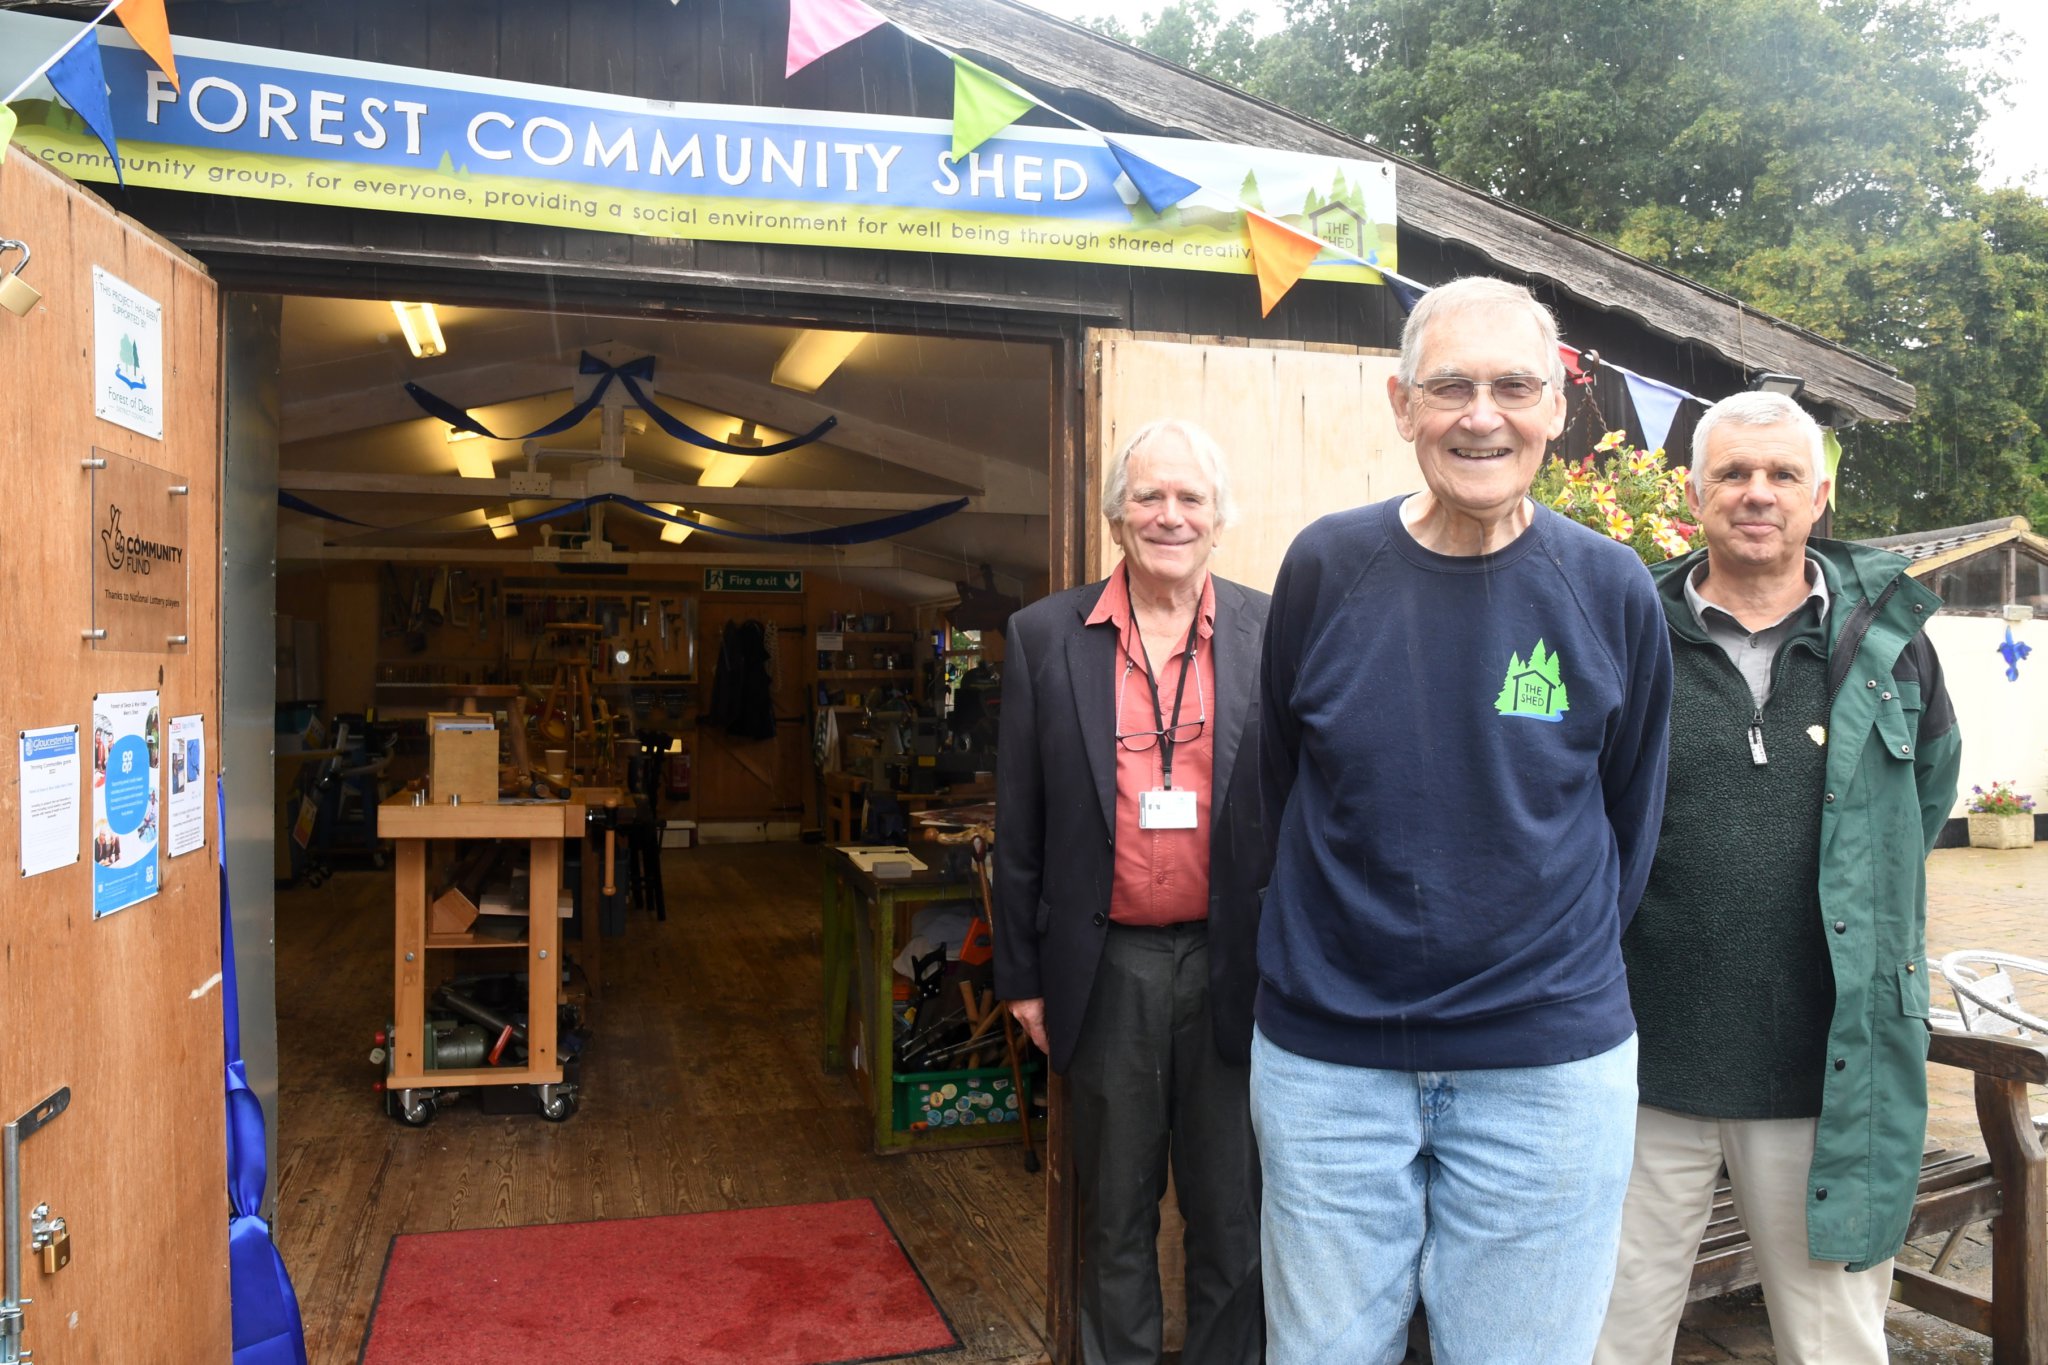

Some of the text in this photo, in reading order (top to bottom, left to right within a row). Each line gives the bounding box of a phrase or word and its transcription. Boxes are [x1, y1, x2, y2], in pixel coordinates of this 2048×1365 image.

[146, 70, 1089, 202] FOREST COMMUNITY SHED
[40, 148, 196, 179] community
[208, 166, 293, 188] group,
[307, 171, 341, 190] for
[353, 179, 473, 204] everyone,
[485, 188, 598, 218] providing
[608, 202, 622, 218] a
[633, 205, 697, 225] social
[708, 210, 847, 233] environment
[858, 216, 887, 236] for
[898, 220, 940, 238] well
[951, 222, 1010, 244] being
[1020, 227, 1100, 252] through
[1109, 235, 1173, 255] shared
[1326, 222, 1350, 235] THE
[108, 386, 128, 405] Forest
[130, 397, 137, 409] of
[138, 398, 153, 416] Dean
[127, 536, 183, 563] COMMUNITY
[127, 556, 151, 575] FUND
[729, 575, 777, 586] Fire exit
[105, 589, 122, 600] Thanks
[1525, 683, 1542, 695] THE
[1520, 694, 1544, 707] SHED
